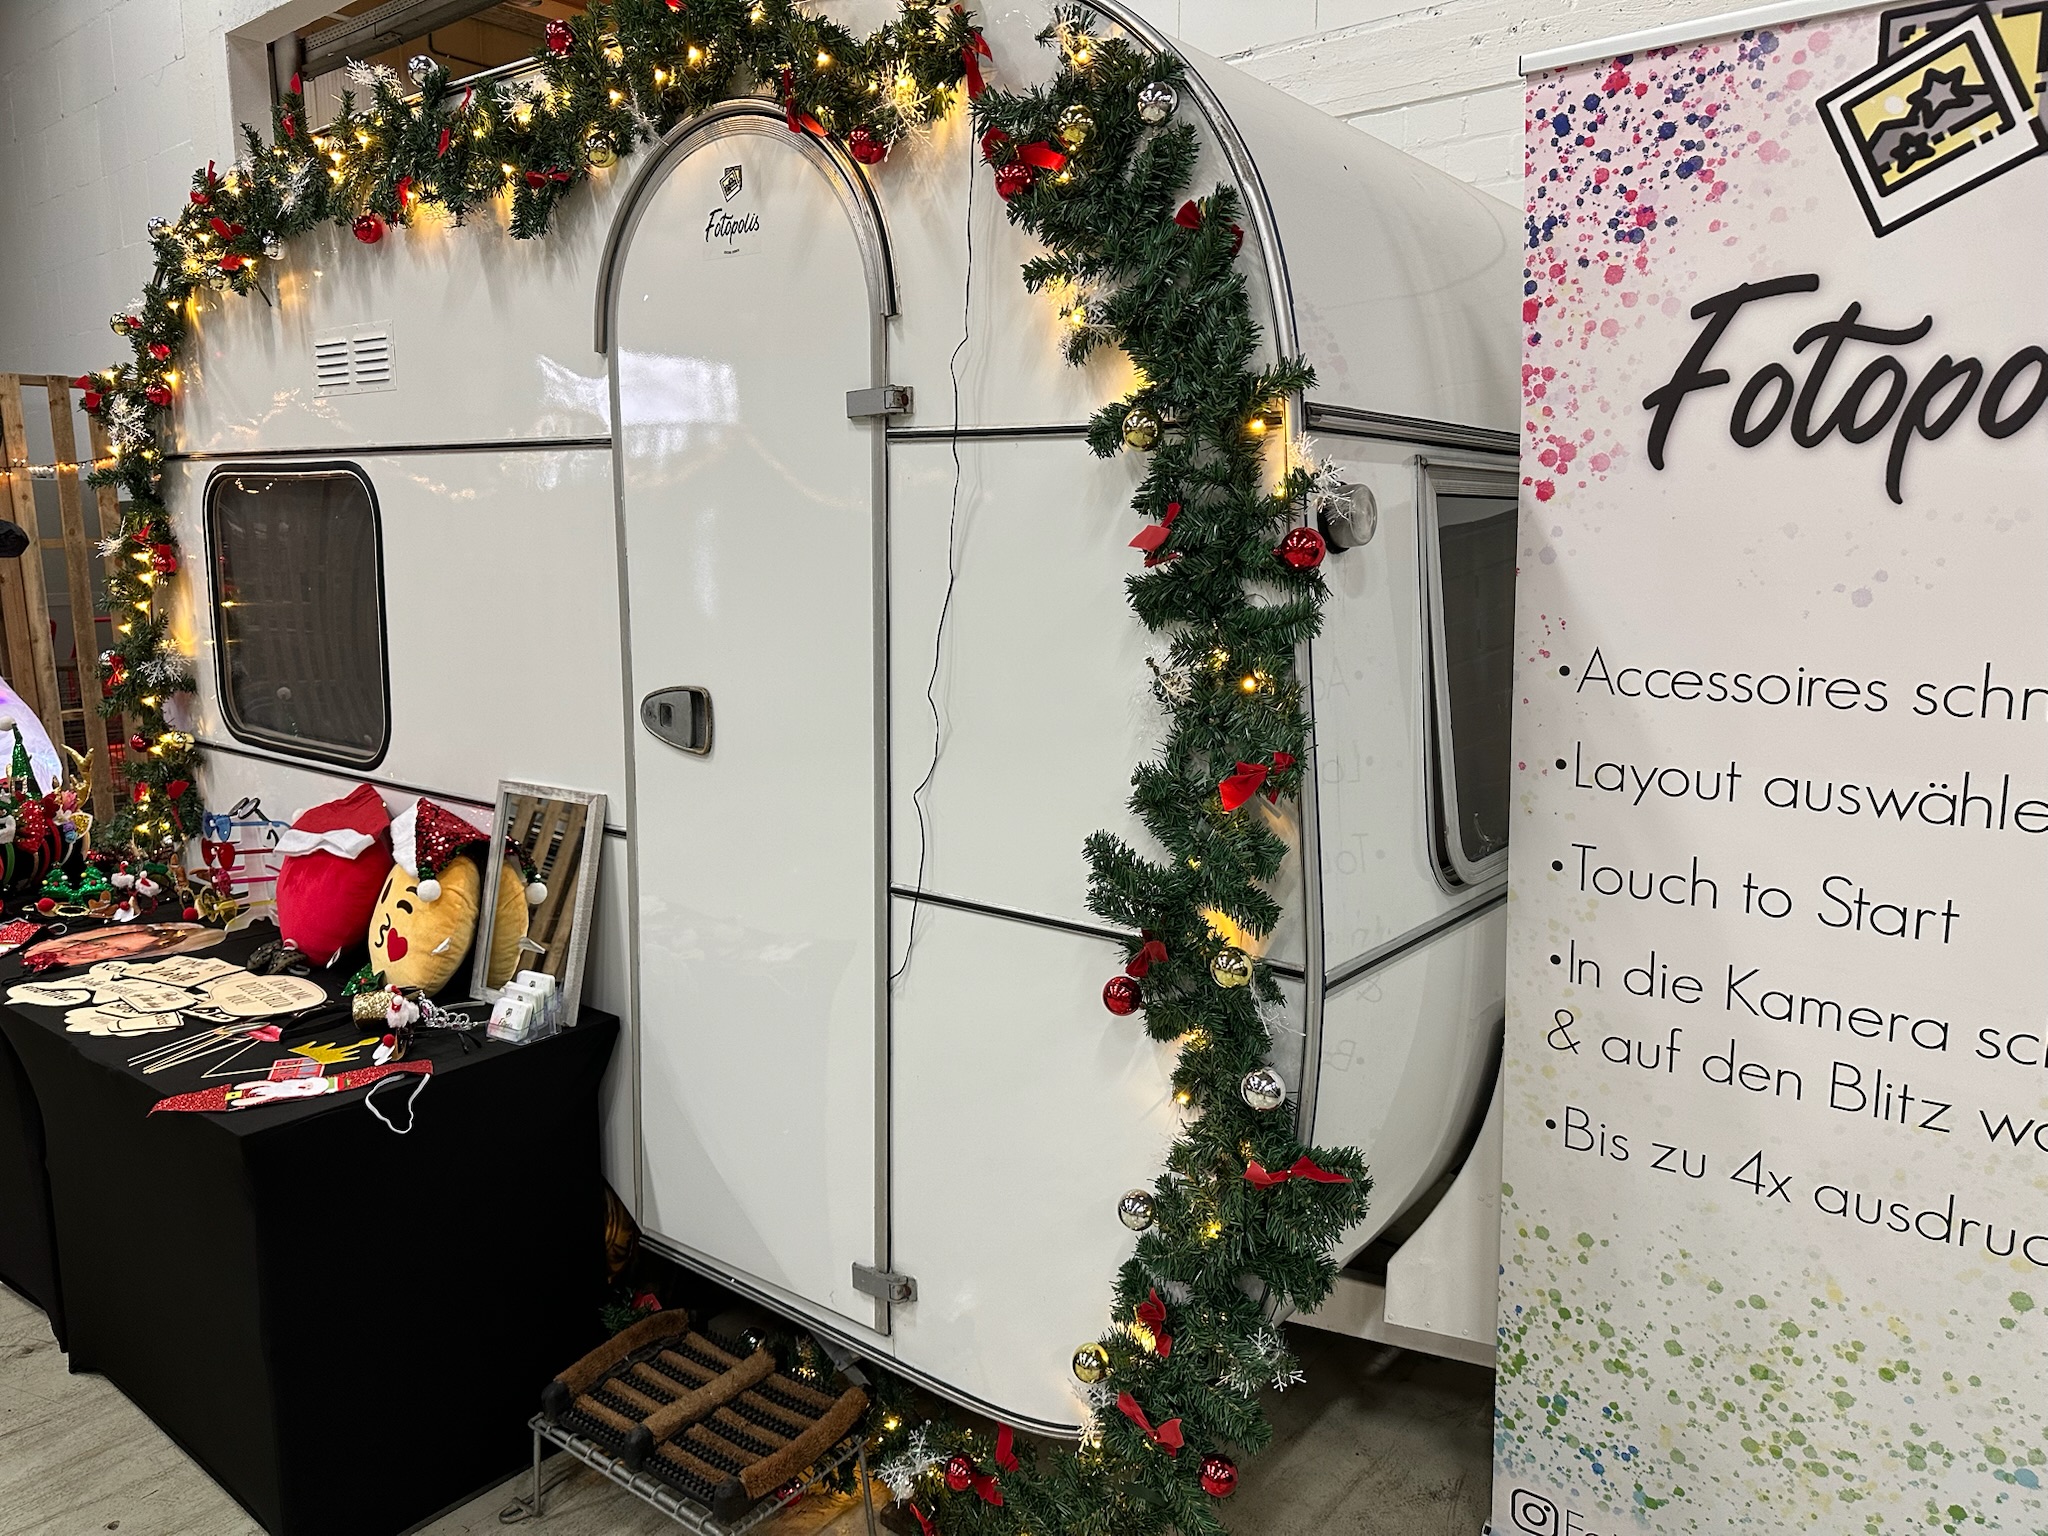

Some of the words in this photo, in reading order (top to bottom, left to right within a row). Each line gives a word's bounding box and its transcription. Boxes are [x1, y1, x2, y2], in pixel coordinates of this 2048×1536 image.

[705, 207, 760, 245] Fotopolis
[1642, 273, 2048, 505] Fotopo
[1576, 646, 1888, 712] Accessoires
[1575, 741, 1742, 806] Layout
[1764, 771, 2048, 834] auswähle
[1571, 843, 1717, 909] Touch
[1742, 872, 1792, 919] to
[1817, 875, 1960, 944] Start
[1569, 939, 1600, 989] In
[1623, 950, 1703, 1004] die
[1726, 964, 1949, 1052] Kamera
[1975, 1028, 2048, 1069] sc
[1547, 1009, 1581, 1055] &
[1601, 1027, 1683, 1073] auf
[1702, 1038, 1802, 1101] den
[1830, 1061, 1953, 1134] Blitz
[1564, 1105, 1629, 1162] Bis
[1650, 1142, 1706, 1179] zu
[1730, 1150, 1793, 1203] 4x
